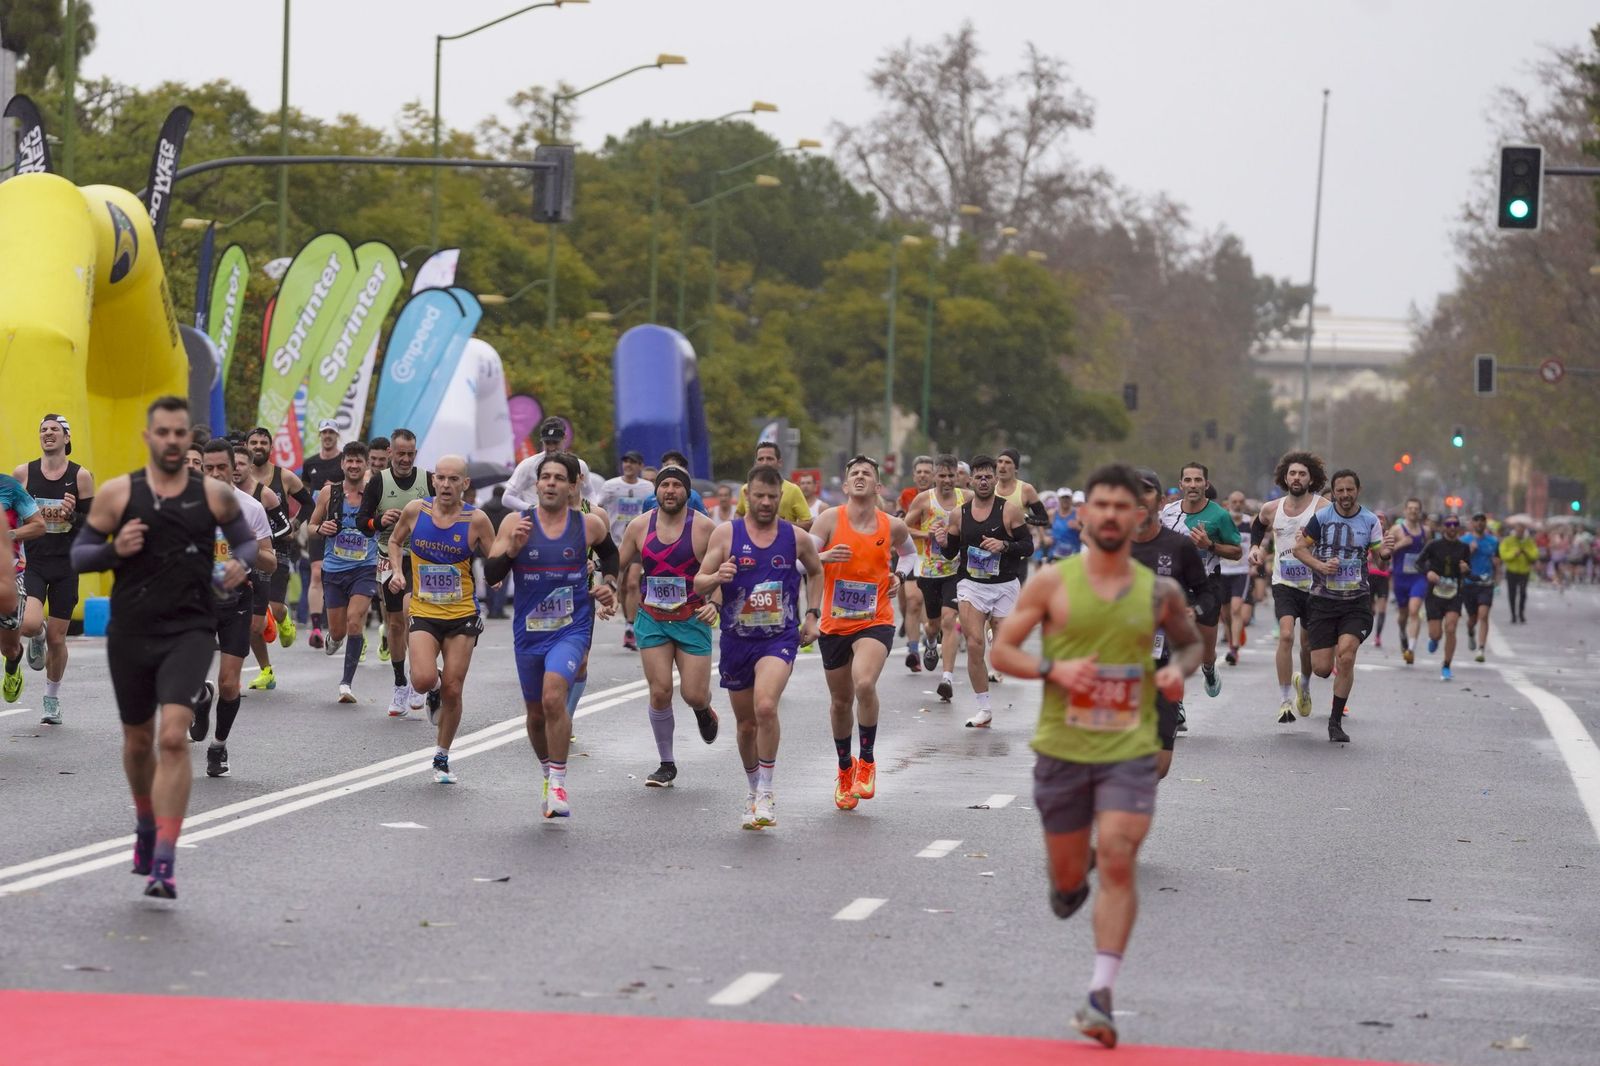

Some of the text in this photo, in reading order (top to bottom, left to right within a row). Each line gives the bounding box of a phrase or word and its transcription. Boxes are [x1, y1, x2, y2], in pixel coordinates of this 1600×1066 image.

[272, 253, 341, 376] Sprinter
[320, 260, 387, 383] Sprinter
[391, 304, 441, 384] Compeed
[340, 534, 362, 546] 3448
[414, 538, 463, 555] agustinos
[1285, 566, 1307, 577] 4033
[424, 574, 452, 587] 2185
[652, 583, 676, 598] 1861
[839, 590, 867, 605] 3794
[534, 599, 562, 613] 1841
[750, 592, 773, 607] 596
